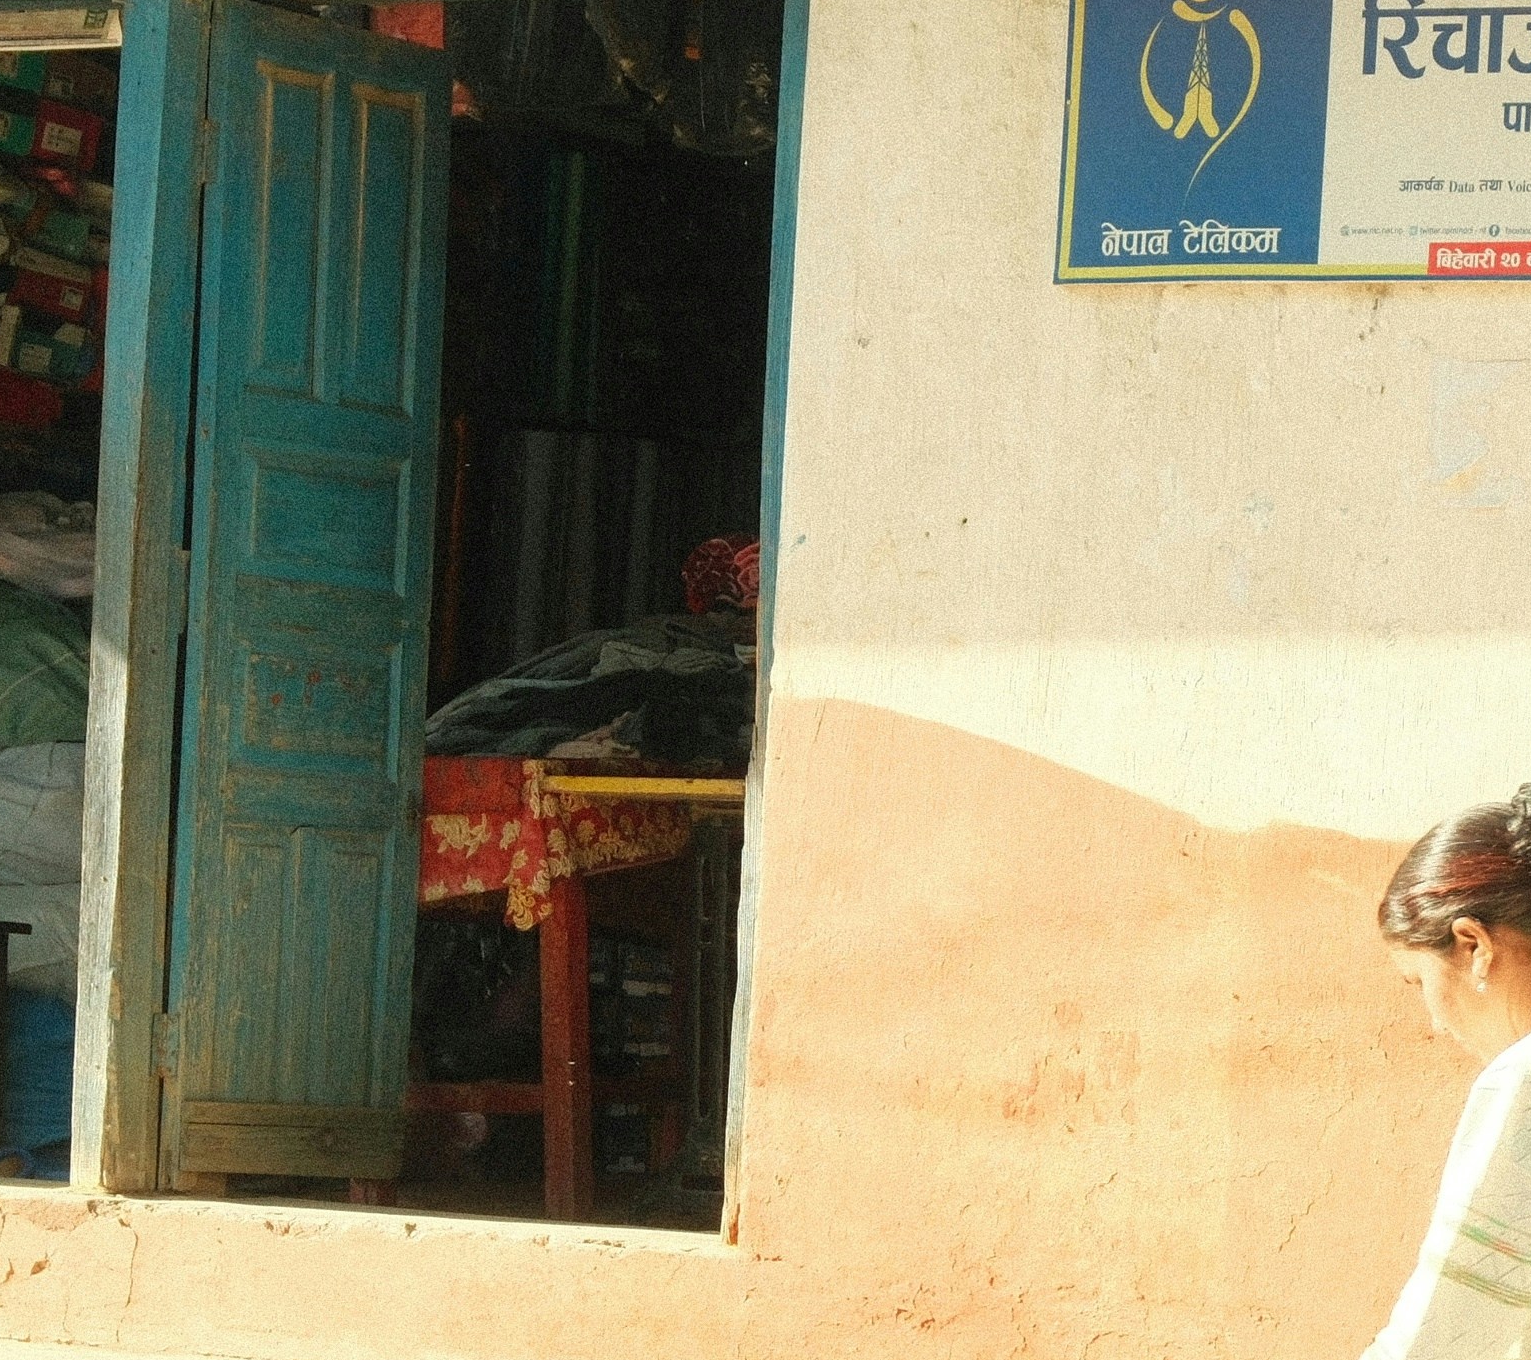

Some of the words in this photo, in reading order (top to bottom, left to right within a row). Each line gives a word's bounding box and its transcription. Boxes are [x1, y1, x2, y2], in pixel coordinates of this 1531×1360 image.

[1399, 176, 1446, 193] आकर्षक
[1449, 180, 1475, 193] Data
[1479, 178, 1503, 192] तथा
[1100, 222, 1170, 259] नेपाल
[1179, 217, 1281, 256] टेलिकम
[1500, 253, 1521, 268] २०
